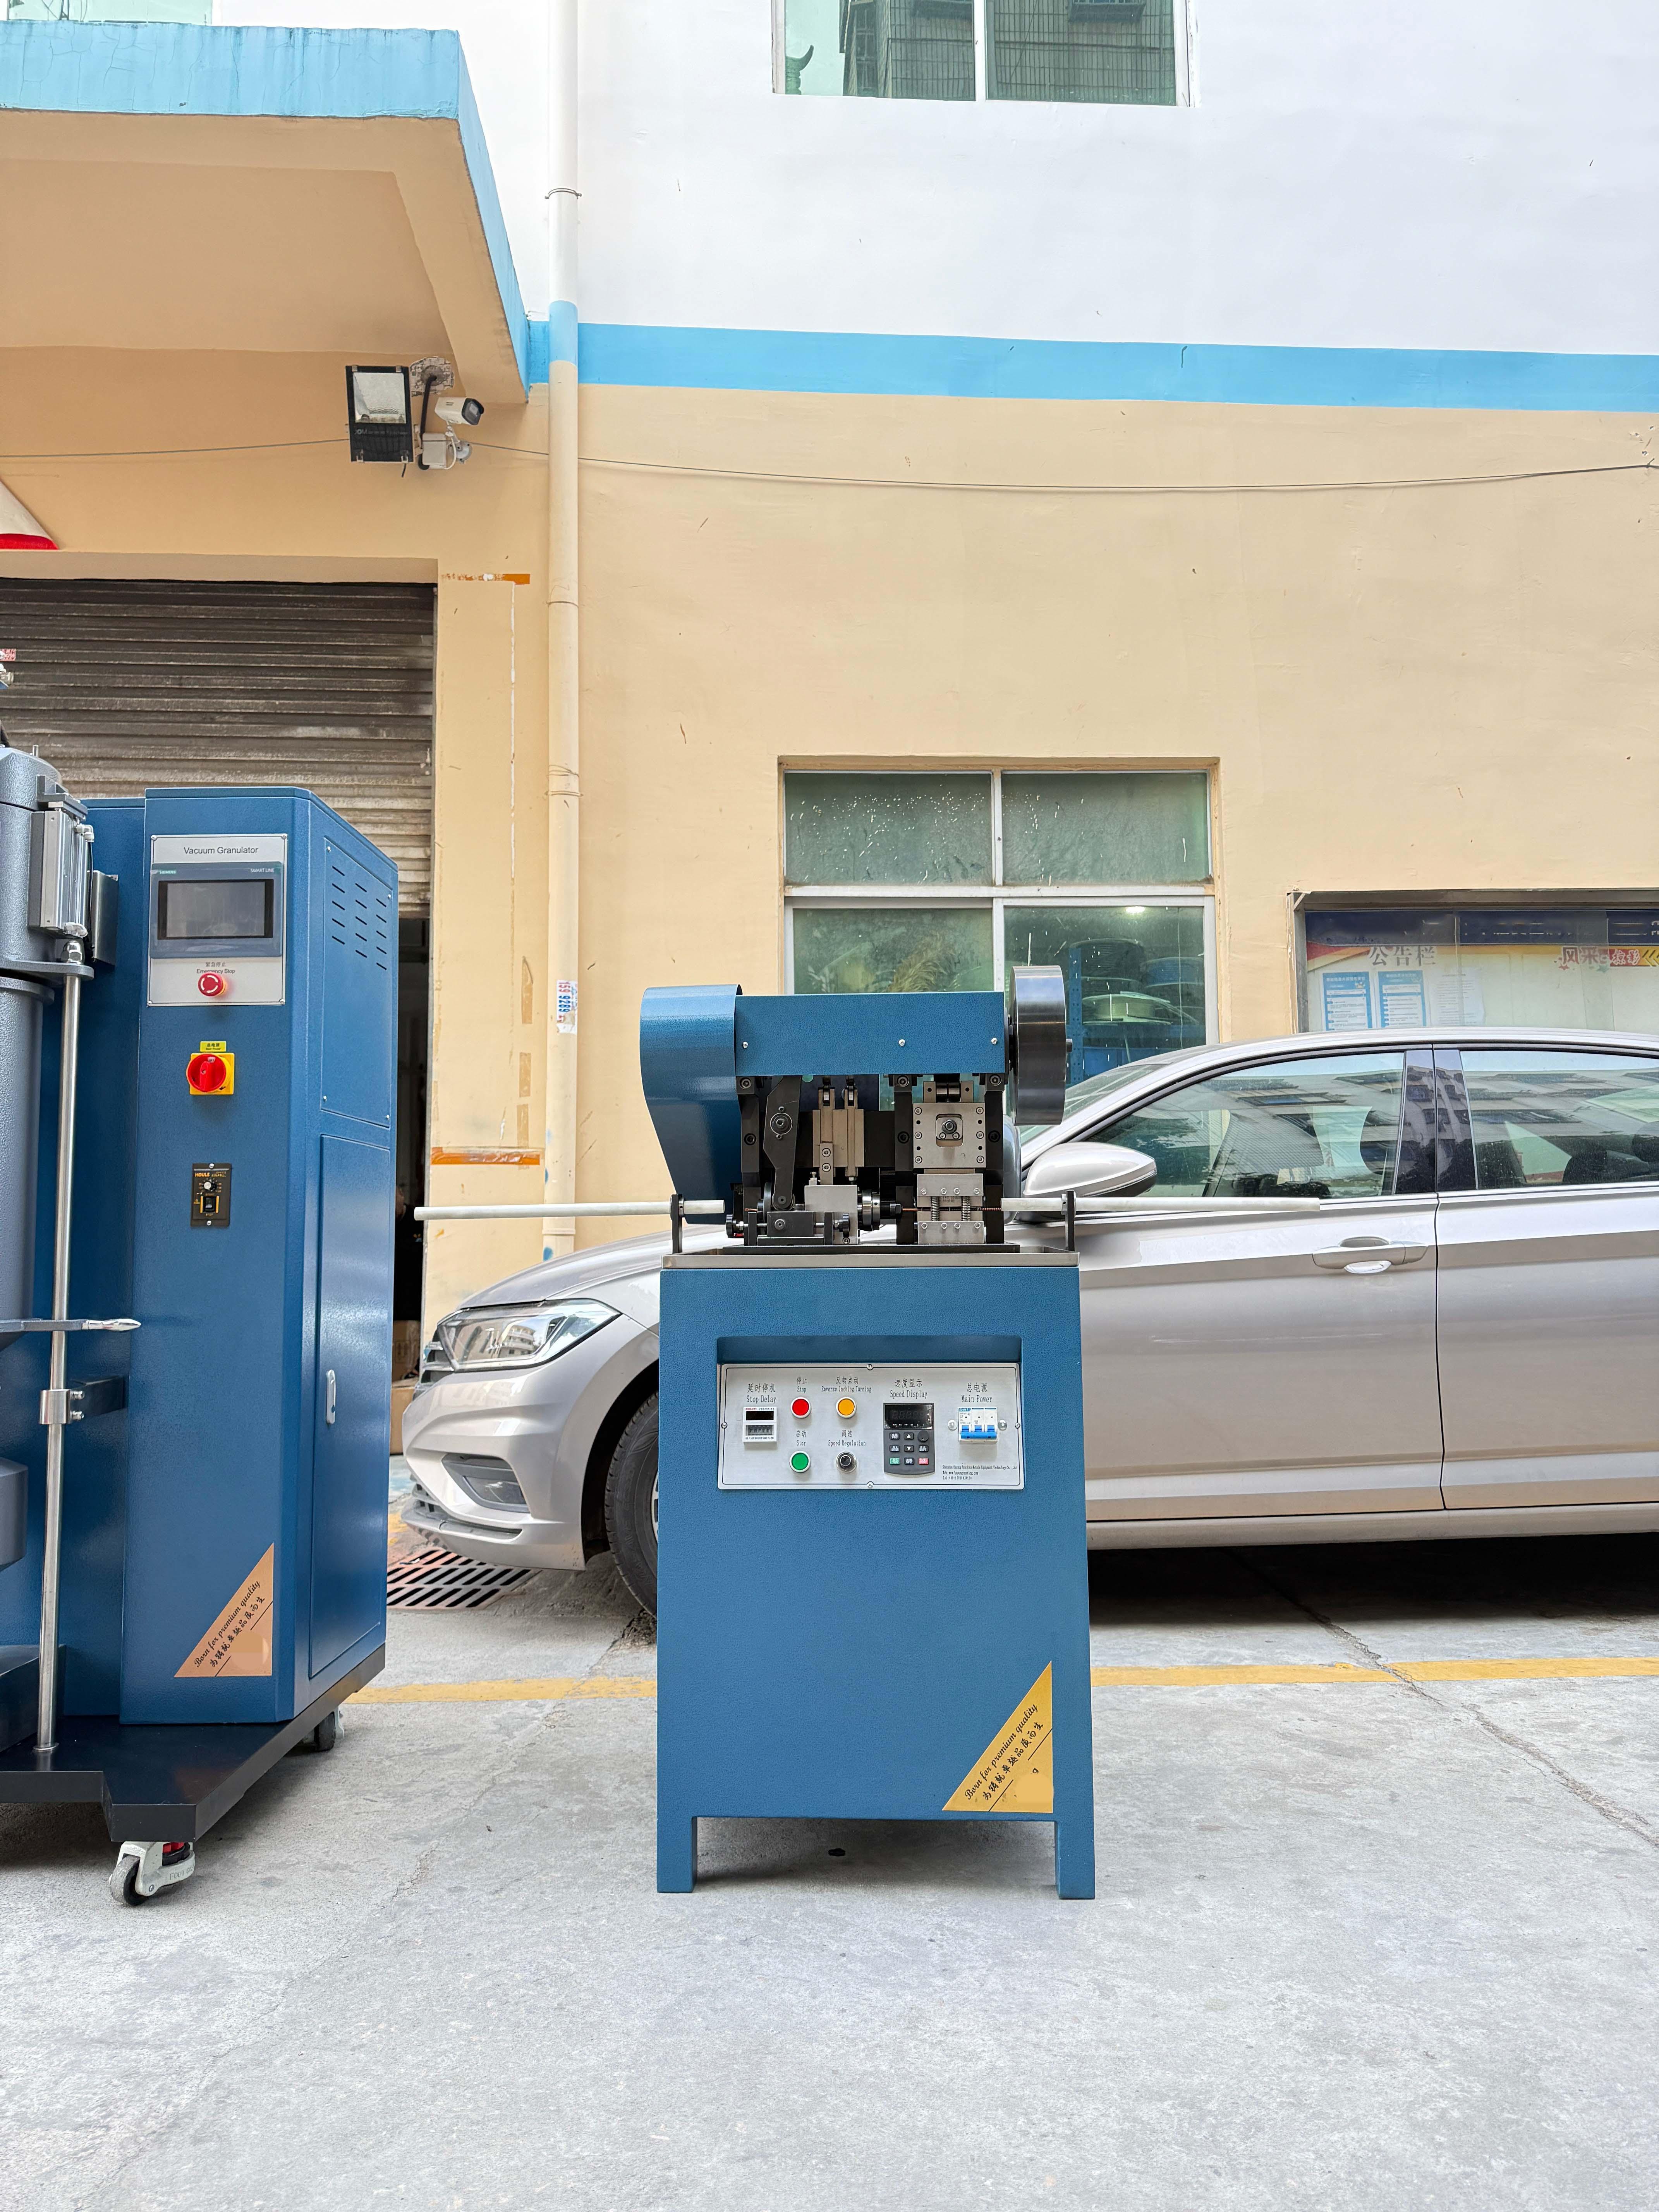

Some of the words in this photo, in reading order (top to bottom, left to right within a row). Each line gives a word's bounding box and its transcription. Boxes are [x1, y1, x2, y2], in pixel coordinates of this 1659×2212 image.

[1370, 945, 1436, 967] 公告栏
[558, 982, 571, 993] 159
[558, 996, 571, 1012] 9289
[836, 1376, 859, 1384] 反转点动
[895, 1378, 922, 1388] 速度显示
[747, 1383, 776, 1393] 延时停机
[967, 1382, 988, 1393] 总电源
[746, 1395, 759, 1404] Stop
[761, 1395, 776, 1404] Delay
[890, 1390, 905, 1399] Speed
[907, 1389, 927, 1399] Display
[795, 1430, 806, 1438] 启动
[842, 1429, 852, 1437] 调速
[194, 1649, 210, 1668] Born
[208, 1637, 219, 1650] for
[218, 1607, 241, 1638] premium
[240, 1581, 261, 1607] quality
[210, 1596, 265, 1667] 为铸就卓越品质而生
[965, 1779, 982, 1800] Born
[980, 1766, 992, 1781] for
[991, 1733, 1016, 1768] premium
[1016, 1704, 1038, 1733] quality
[982, 1722, 1044, 1800] 为铸就卓越品质而生
